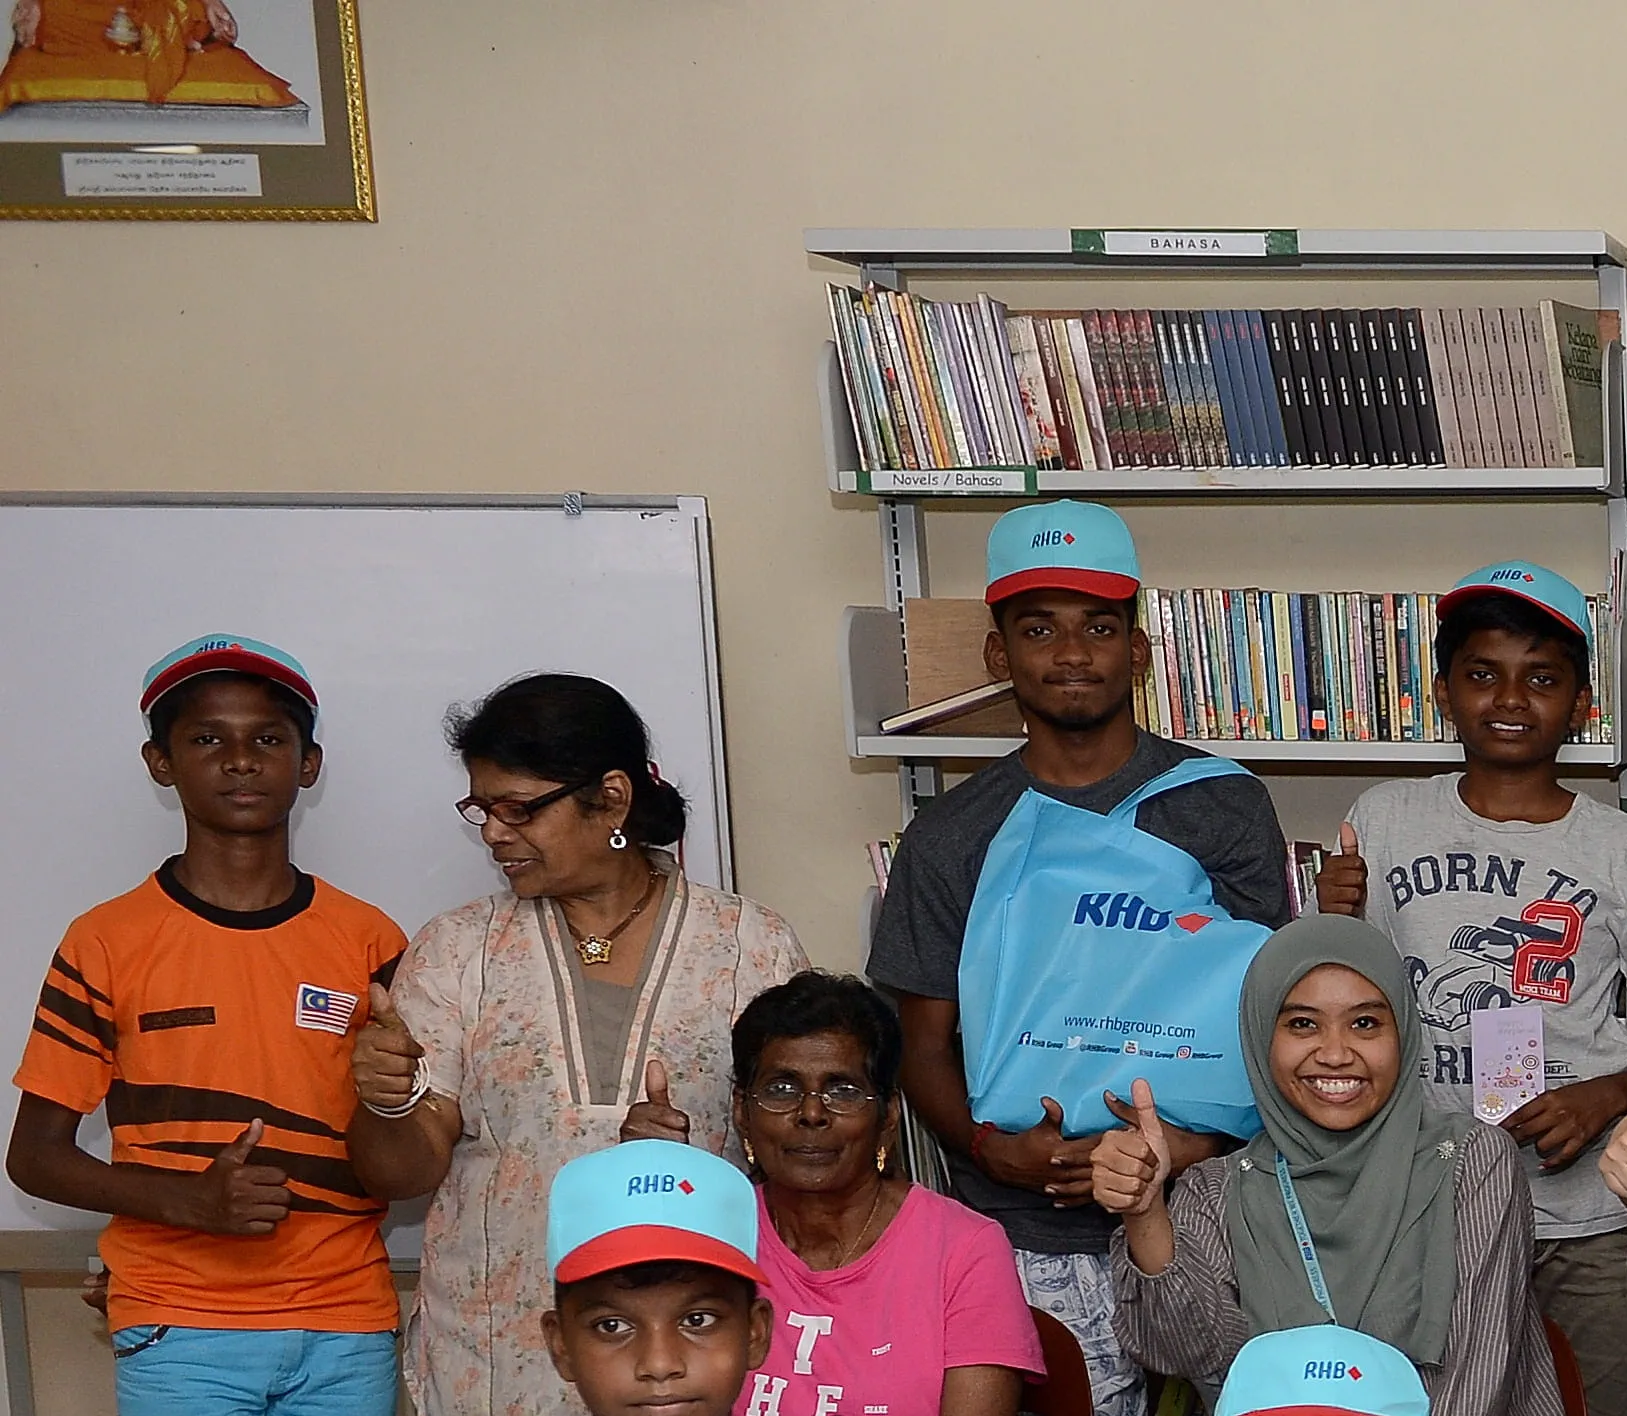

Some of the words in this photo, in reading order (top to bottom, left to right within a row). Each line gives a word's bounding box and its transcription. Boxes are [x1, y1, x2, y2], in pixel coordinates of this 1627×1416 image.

[1150, 238, 1222, 249] BAHASA
[893, 473, 940, 487] Novels
[957, 473, 1003, 487] Bahasa
[1032, 530, 1062, 548] RHB
[1491, 570, 1522, 582] RHB
[1386, 853, 1525, 911] BORN
[1545, 869, 1598, 922] TO
[1512, 900, 1584, 1004] 2
[1064, 1013, 1196, 1040] www.rhbgroup.com
[628, 1175, 675, 1196] RHB
[786, 1311, 834, 1375] T
[1304, 1361, 1346, 1381] RHB
